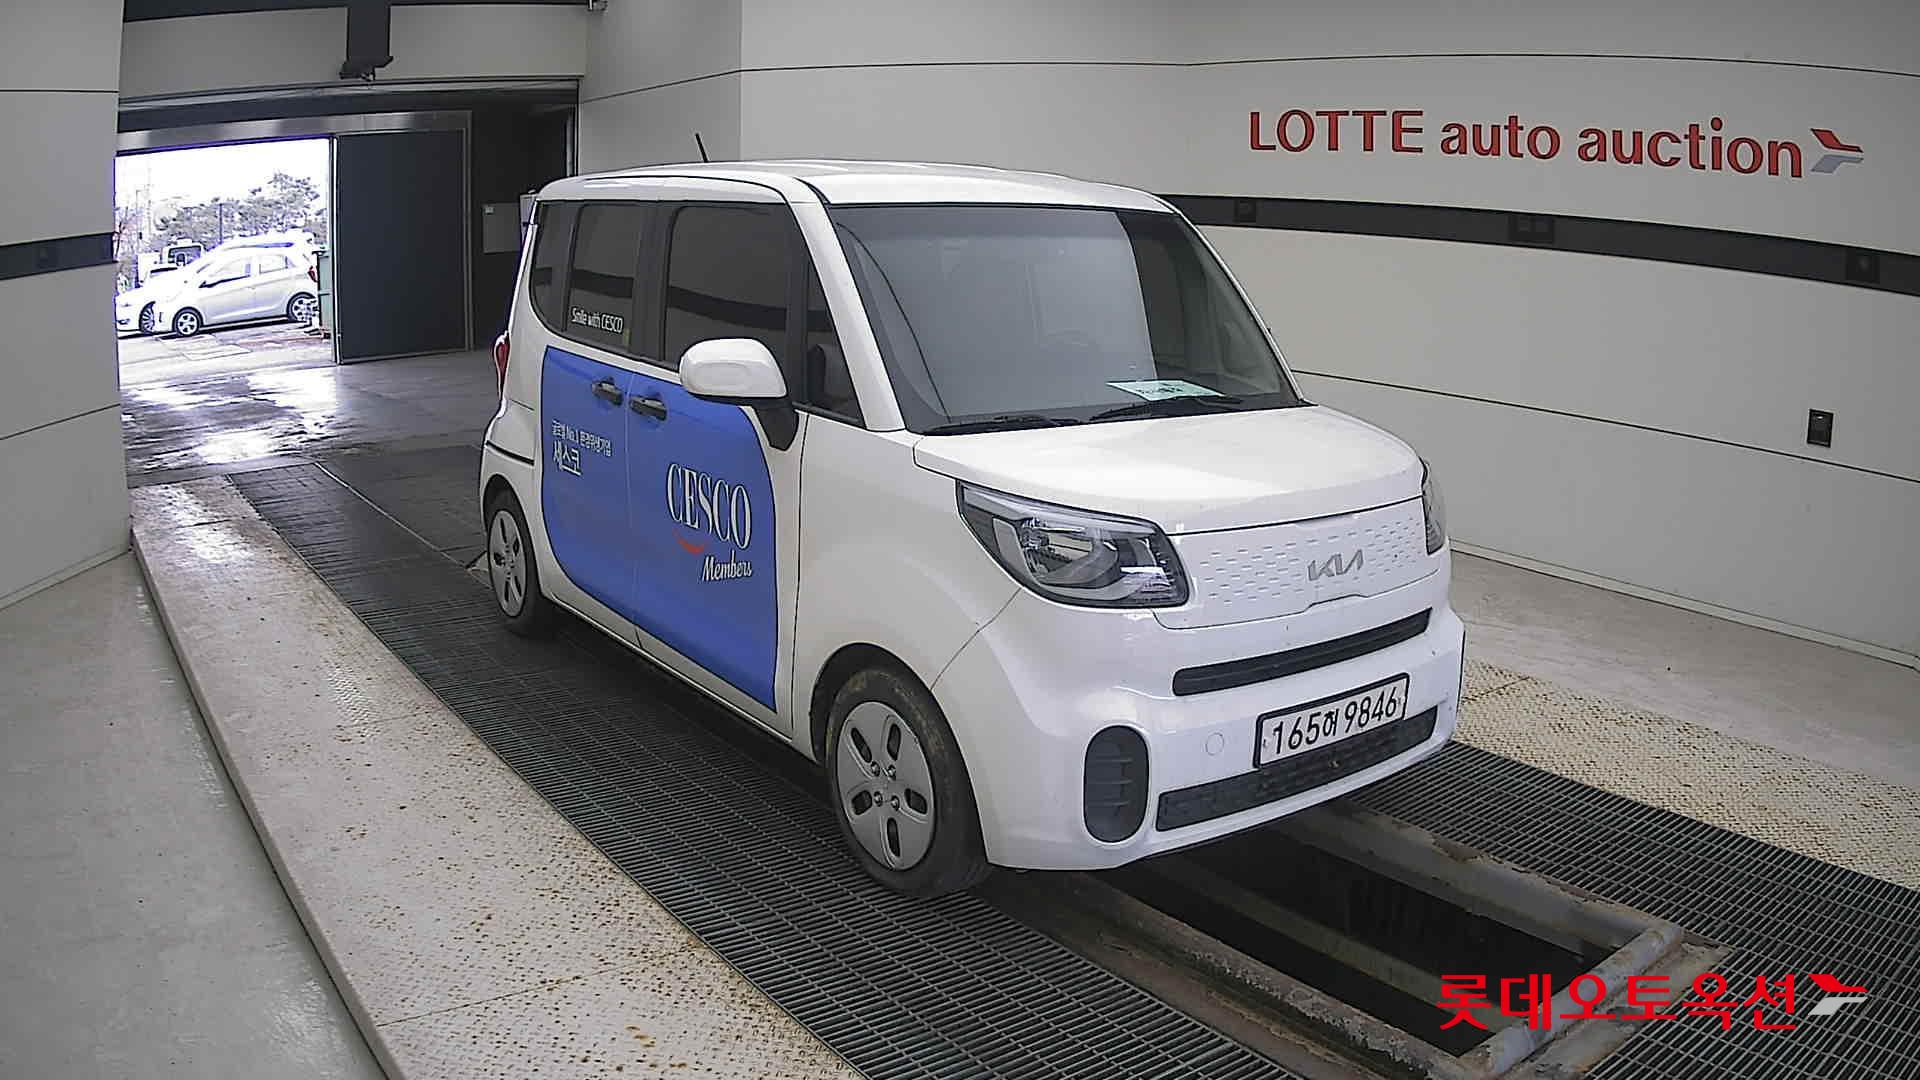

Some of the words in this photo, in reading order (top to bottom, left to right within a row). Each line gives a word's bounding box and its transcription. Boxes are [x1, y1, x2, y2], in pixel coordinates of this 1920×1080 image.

[1250, 109, 1423, 152] LOTTE
[1440, 115, 1560, 159] auto
[1577, 117, 1802, 178] auction
[601, 314, 623, 333] CESCO
[553, 440, 581, 476] 세스코
[667, 463, 752, 549] CESCO
[702, 549, 753, 581] Members
[1273, 708, 1340, 755] 165허
[1344, 686, 1398, 734] 9846
